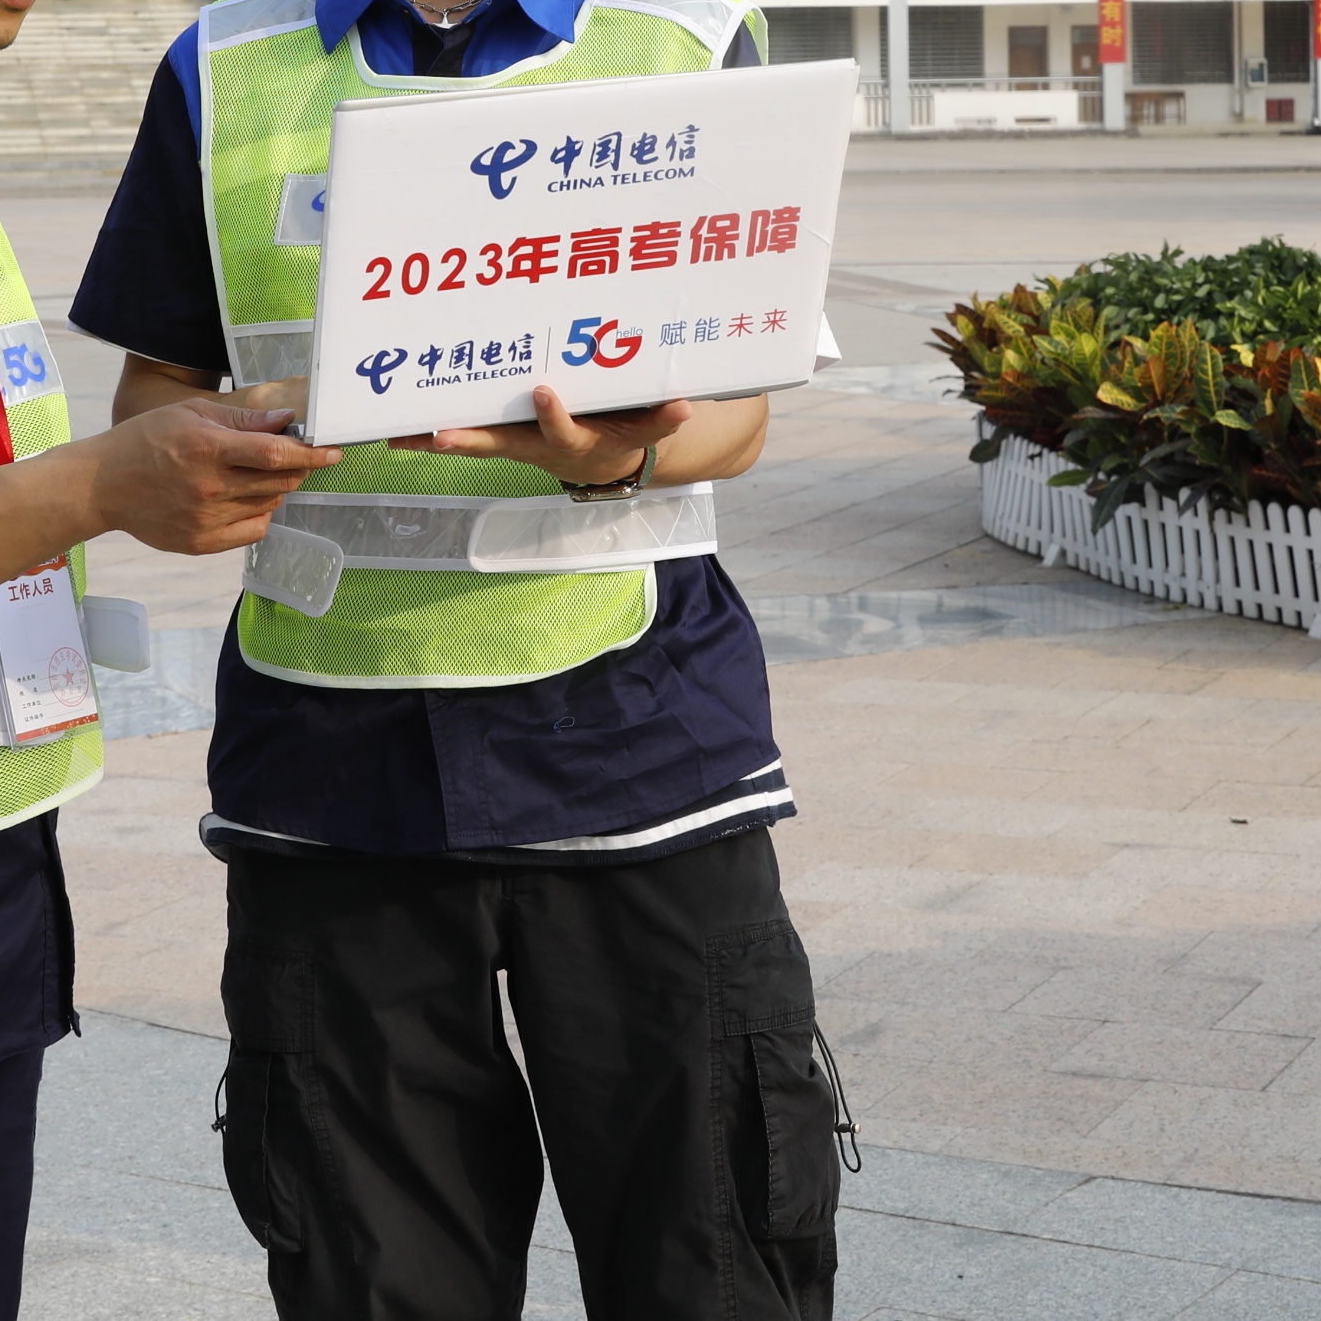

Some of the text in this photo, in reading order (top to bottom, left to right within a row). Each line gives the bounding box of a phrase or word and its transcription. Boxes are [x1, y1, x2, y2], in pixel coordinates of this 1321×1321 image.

[550, 124, 700, 178] 中国电信
[547, 166, 696, 193] CHINA TELECOM
[362, 206, 801, 301] 2023年高考保障
[561, 316, 644, 368] 5G
[615, 326, 644, 339] hello
[659, 308, 788, 348] 赋能未来
[2, 343, 47, 387] 5G
[417, 333, 535, 377] 中国电信
[416, 365, 533, 389] CHINA TELECOM
[7, 577, 55, 603] 工作人员
